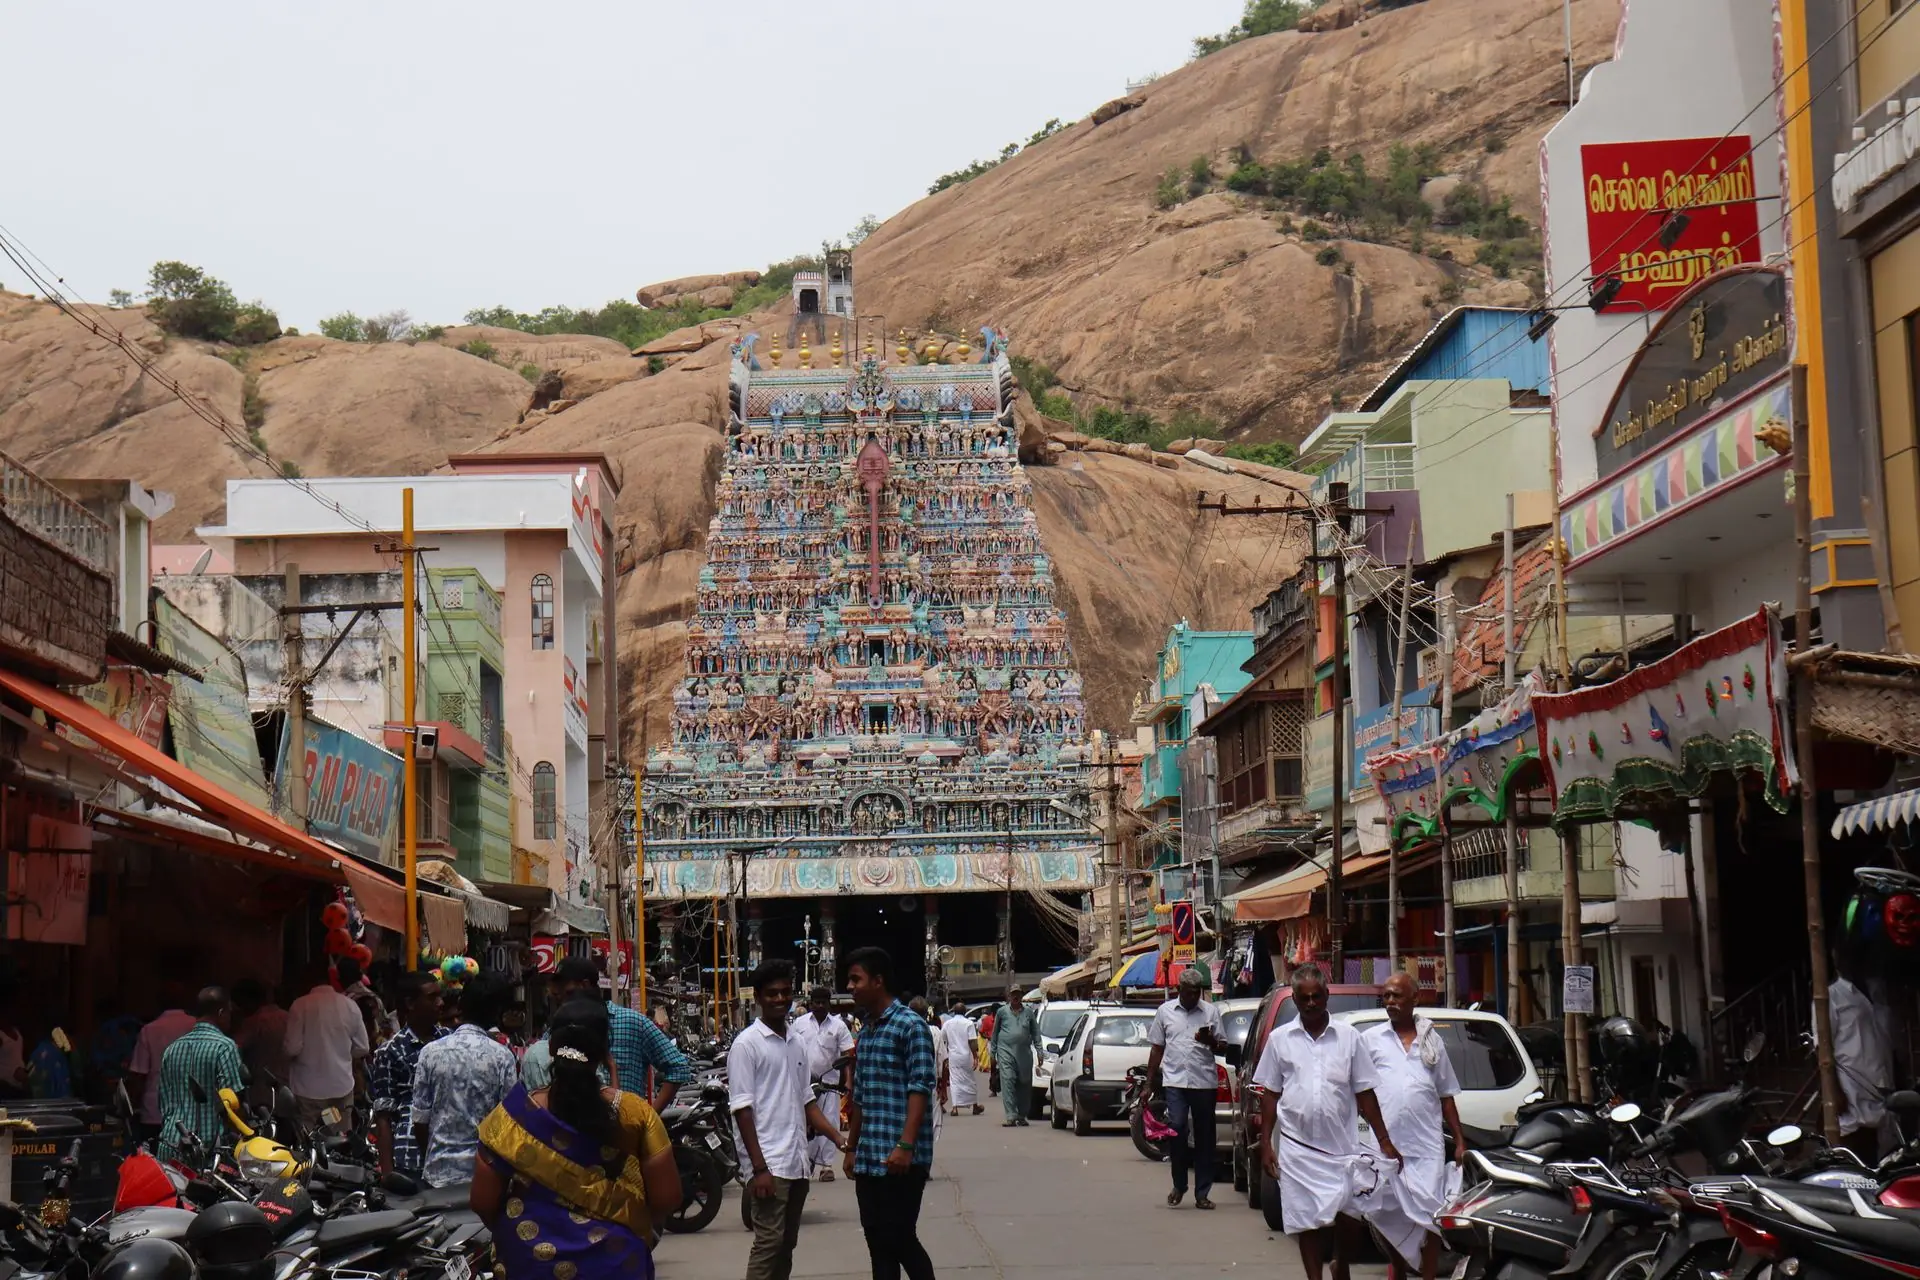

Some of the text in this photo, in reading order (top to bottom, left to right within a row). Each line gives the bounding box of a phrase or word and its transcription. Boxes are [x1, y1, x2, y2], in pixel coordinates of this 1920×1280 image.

[1589, 161, 1658, 213] செல்வ
[1618, 231, 1743, 295] மஹால்
[1843, 1176, 1878, 1185] HERO
